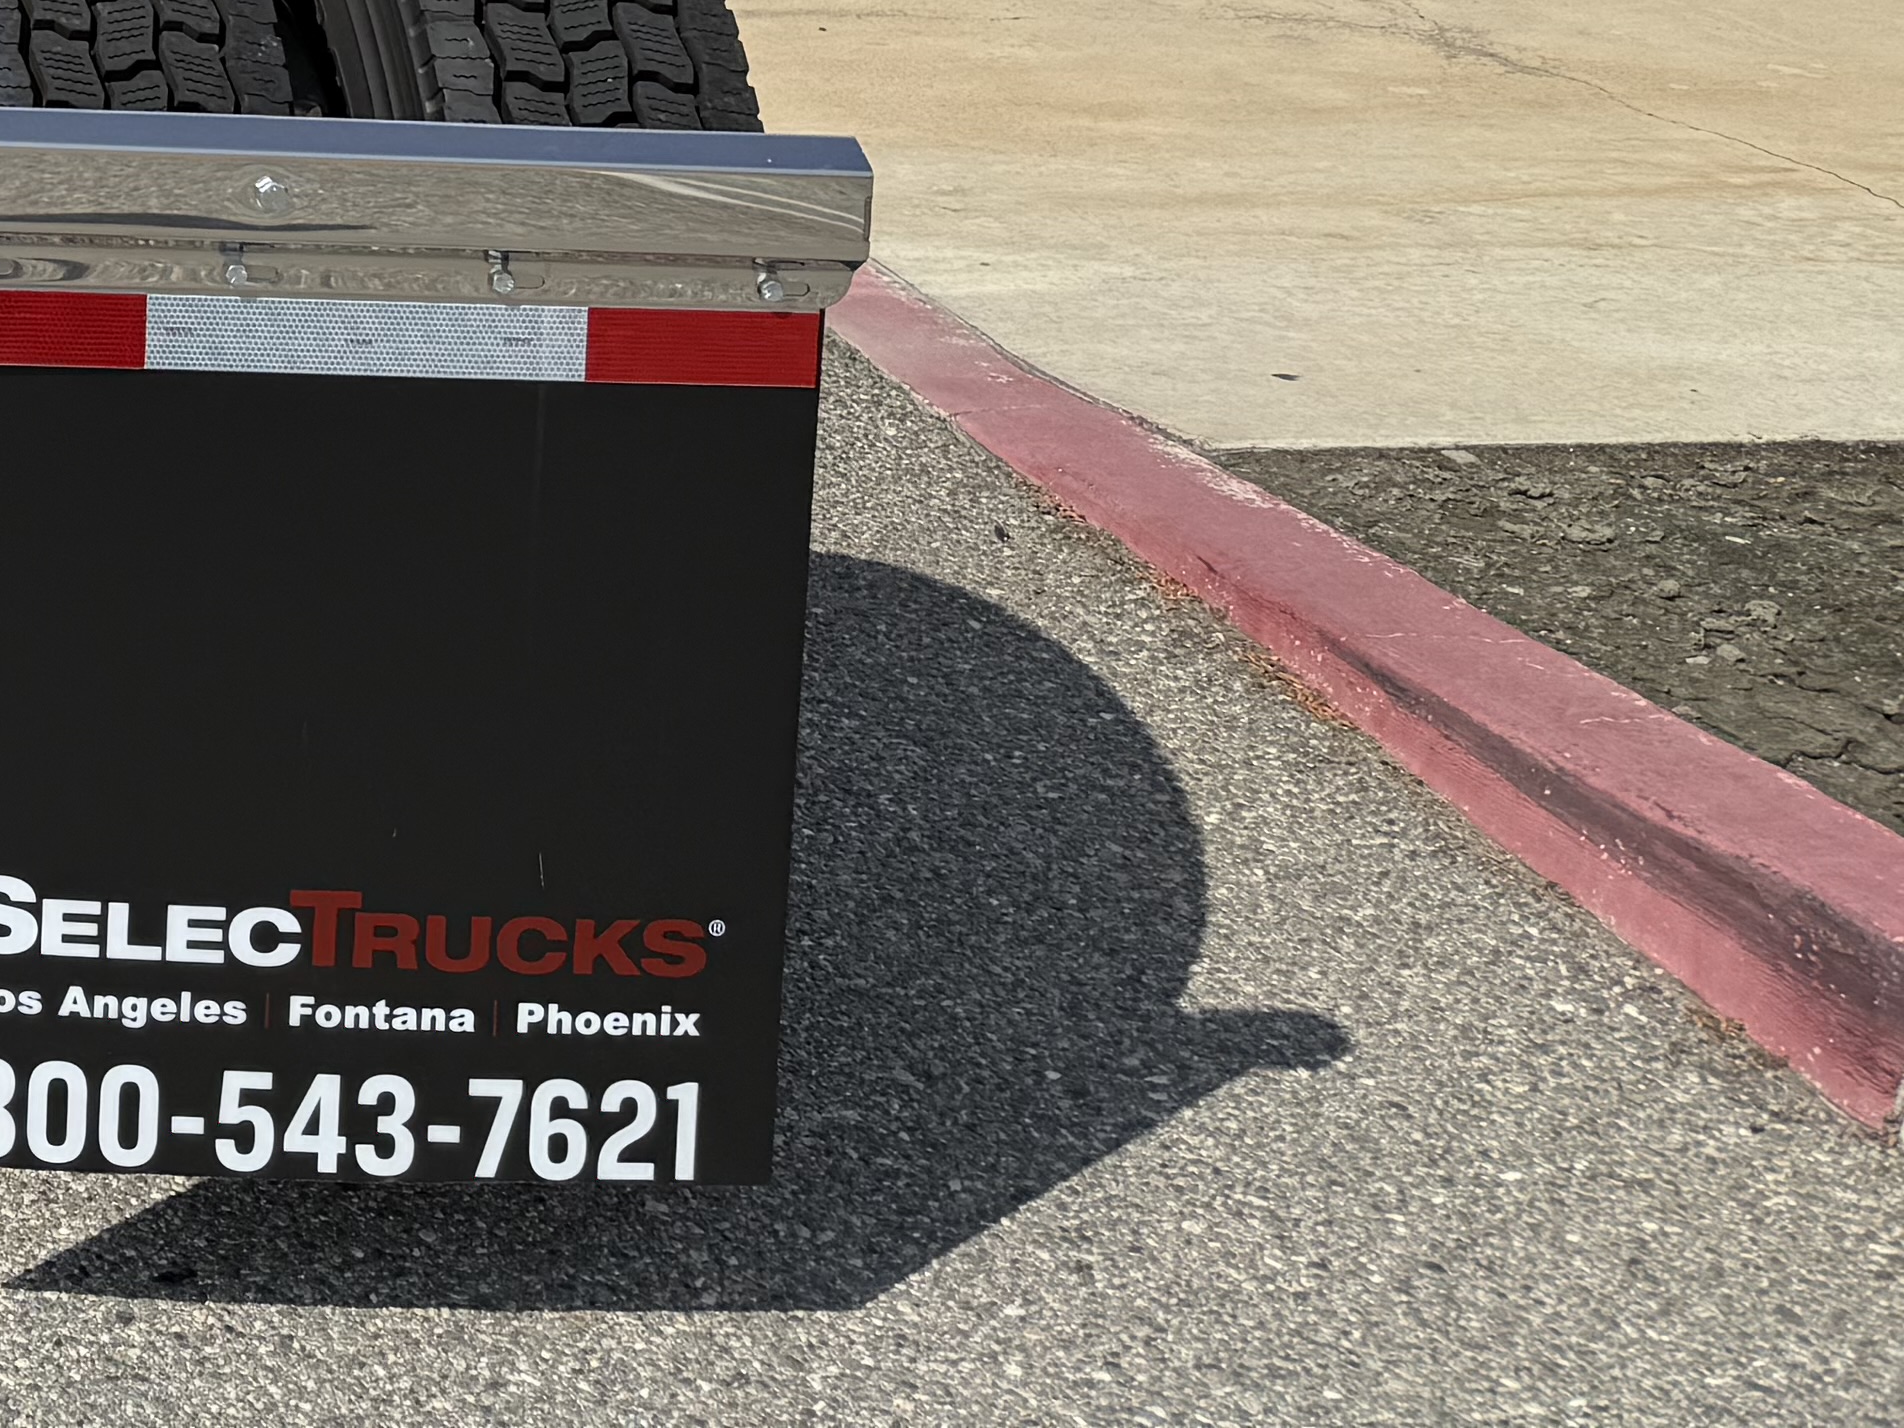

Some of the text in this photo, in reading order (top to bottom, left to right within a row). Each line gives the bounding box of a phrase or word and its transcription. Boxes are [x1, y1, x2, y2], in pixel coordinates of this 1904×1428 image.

[57, 985, 247, 1029] Angeles
[288, 995, 475, 1034] Fontana
[516, 1002, 701, 1037] Phoenix
